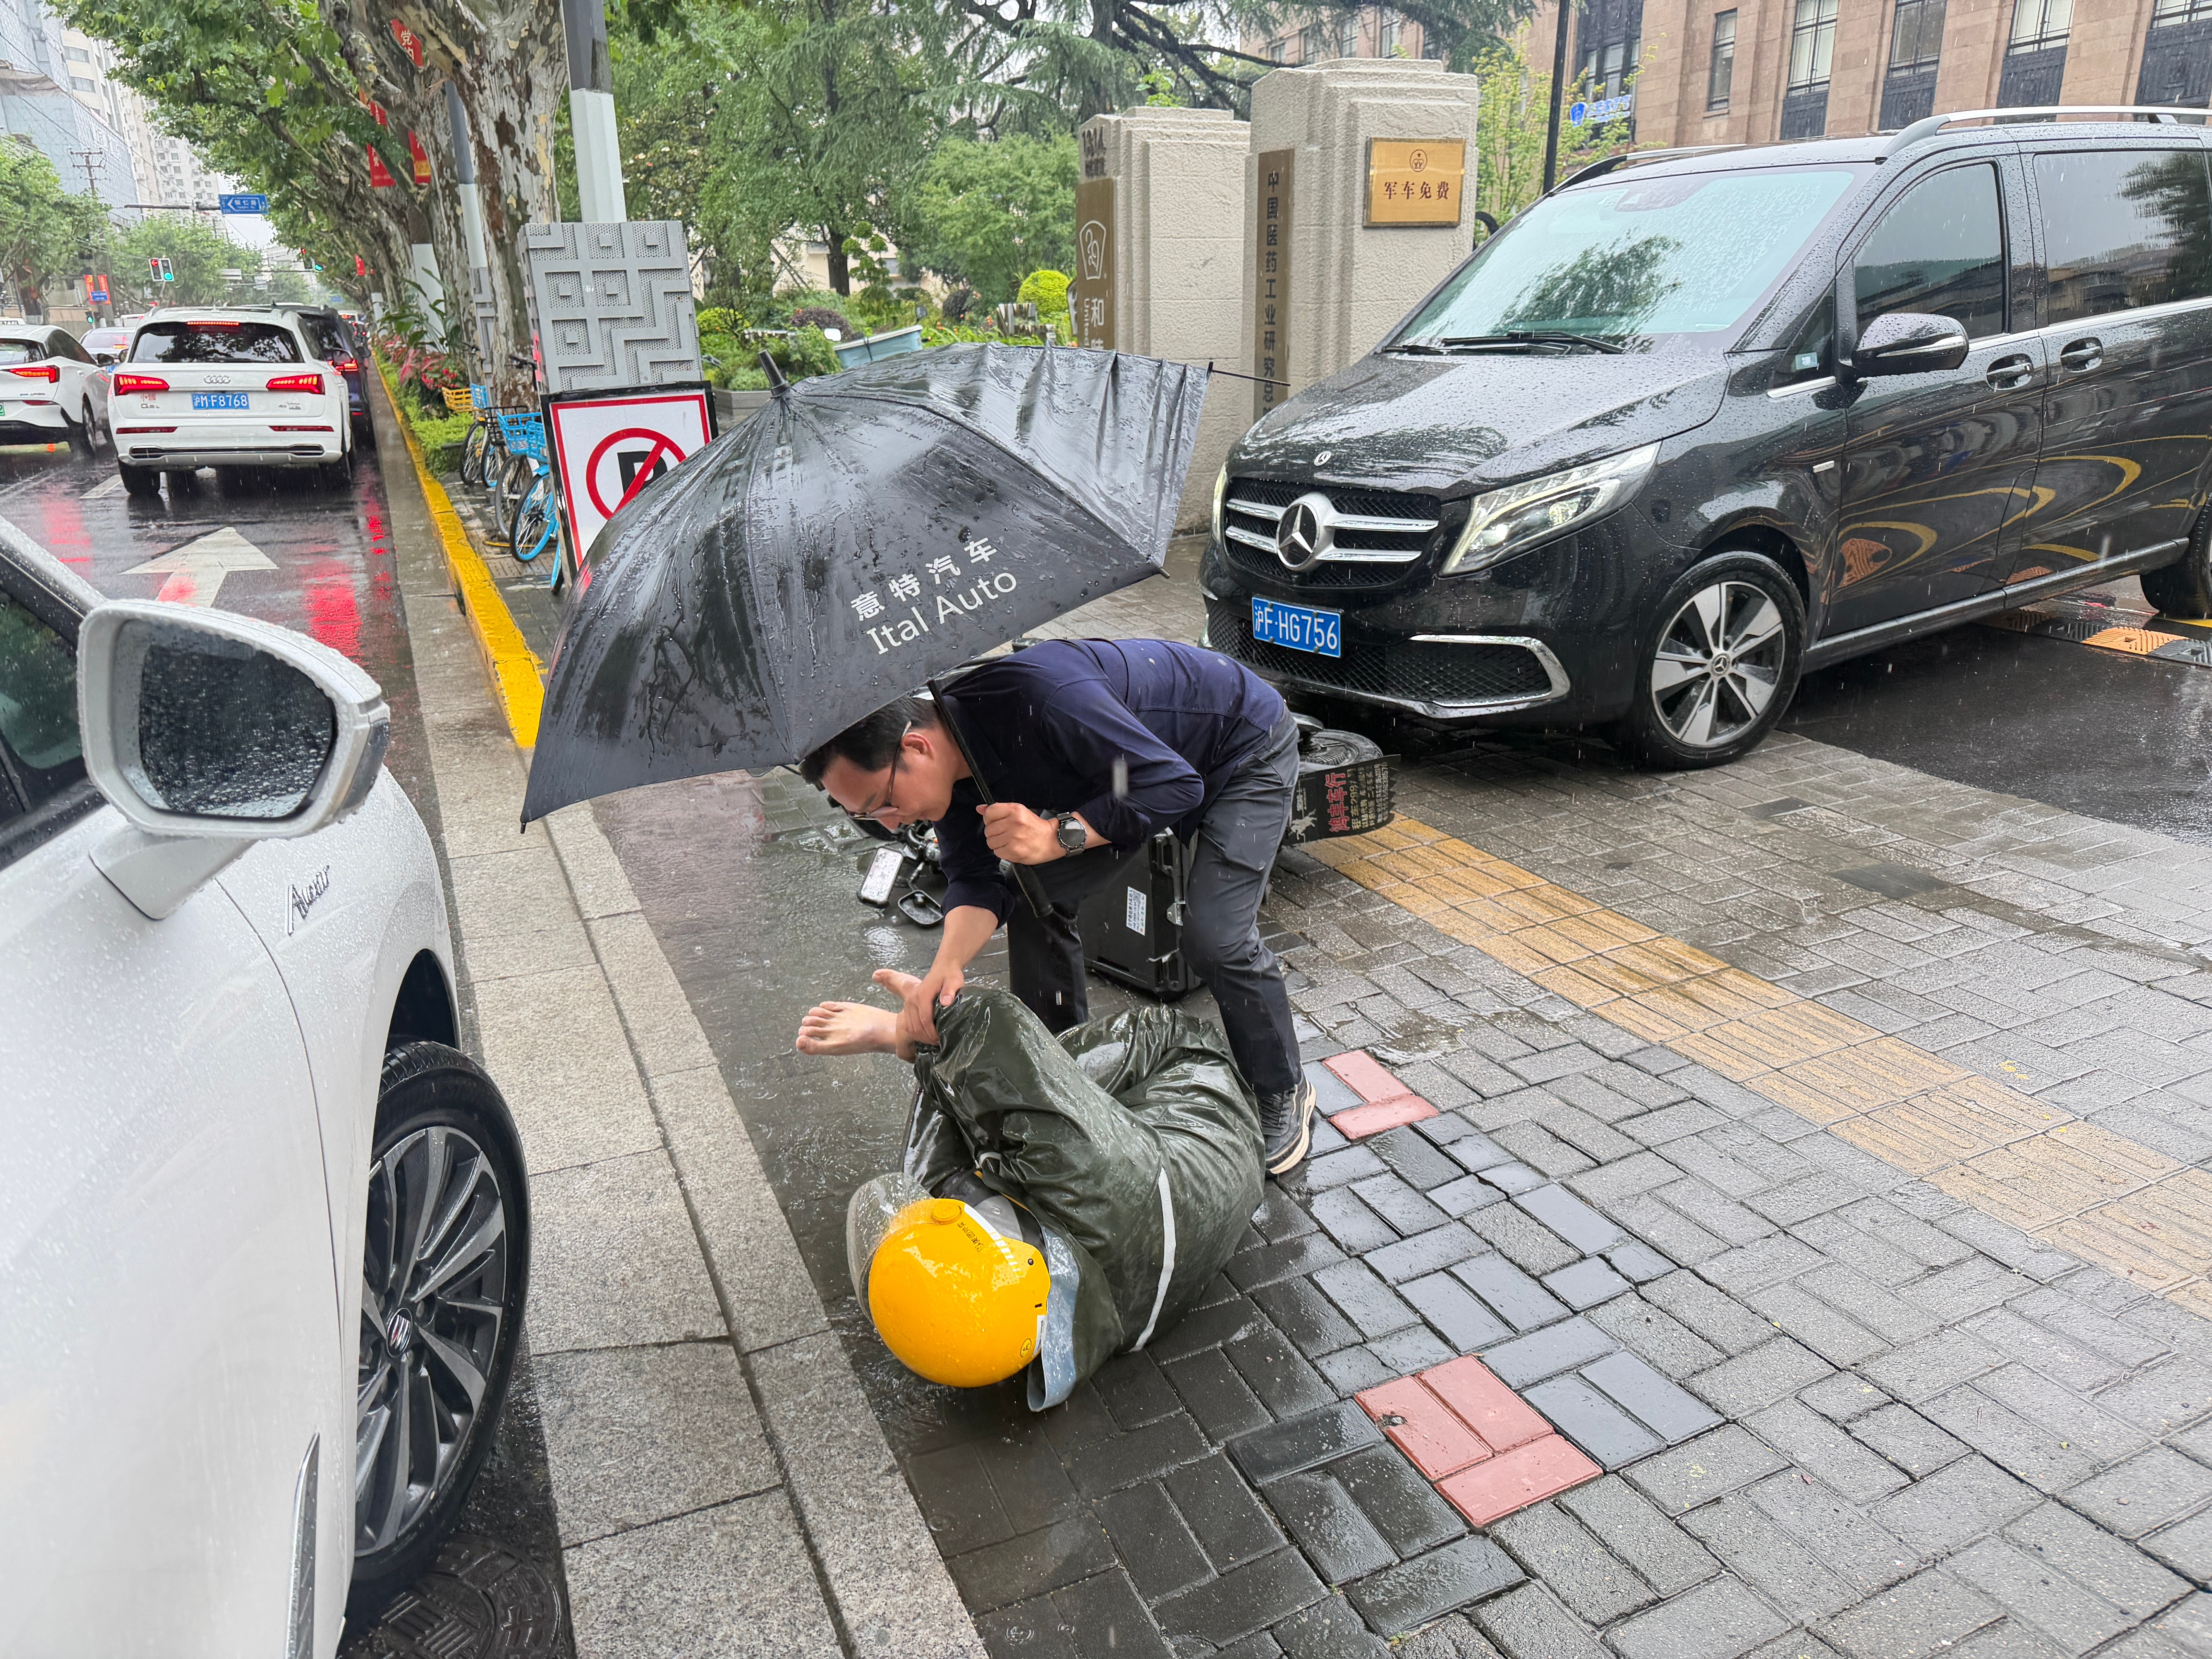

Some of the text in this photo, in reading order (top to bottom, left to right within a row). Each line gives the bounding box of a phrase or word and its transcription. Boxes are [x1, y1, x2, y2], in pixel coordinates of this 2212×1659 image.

[1383, 181, 1449, 200] 军车免费
[1262, 172, 1279, 417] 中国医药工业研究总
[851, 538, 997, 621] 意特汽车
[867, 572, 1017, 654] Ital Auto
[288, 865, 330, 937] Avenir
